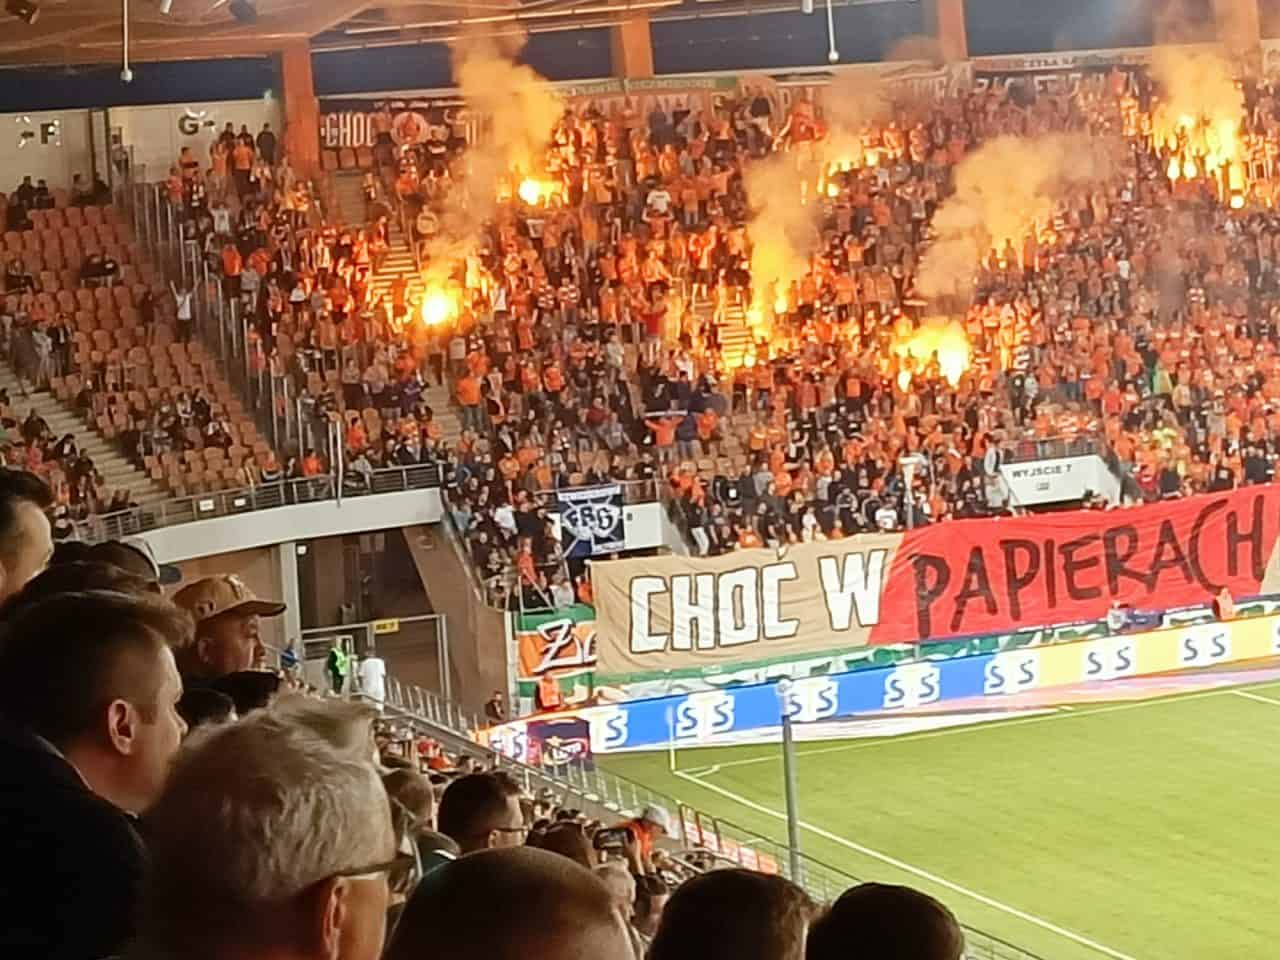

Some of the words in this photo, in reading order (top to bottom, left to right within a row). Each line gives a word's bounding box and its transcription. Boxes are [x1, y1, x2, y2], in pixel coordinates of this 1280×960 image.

[629, 547, 799, 654] CHOĆ
[818, 549, 887, 632] W
[911, 495, 1269, 639] PAPIERACH
